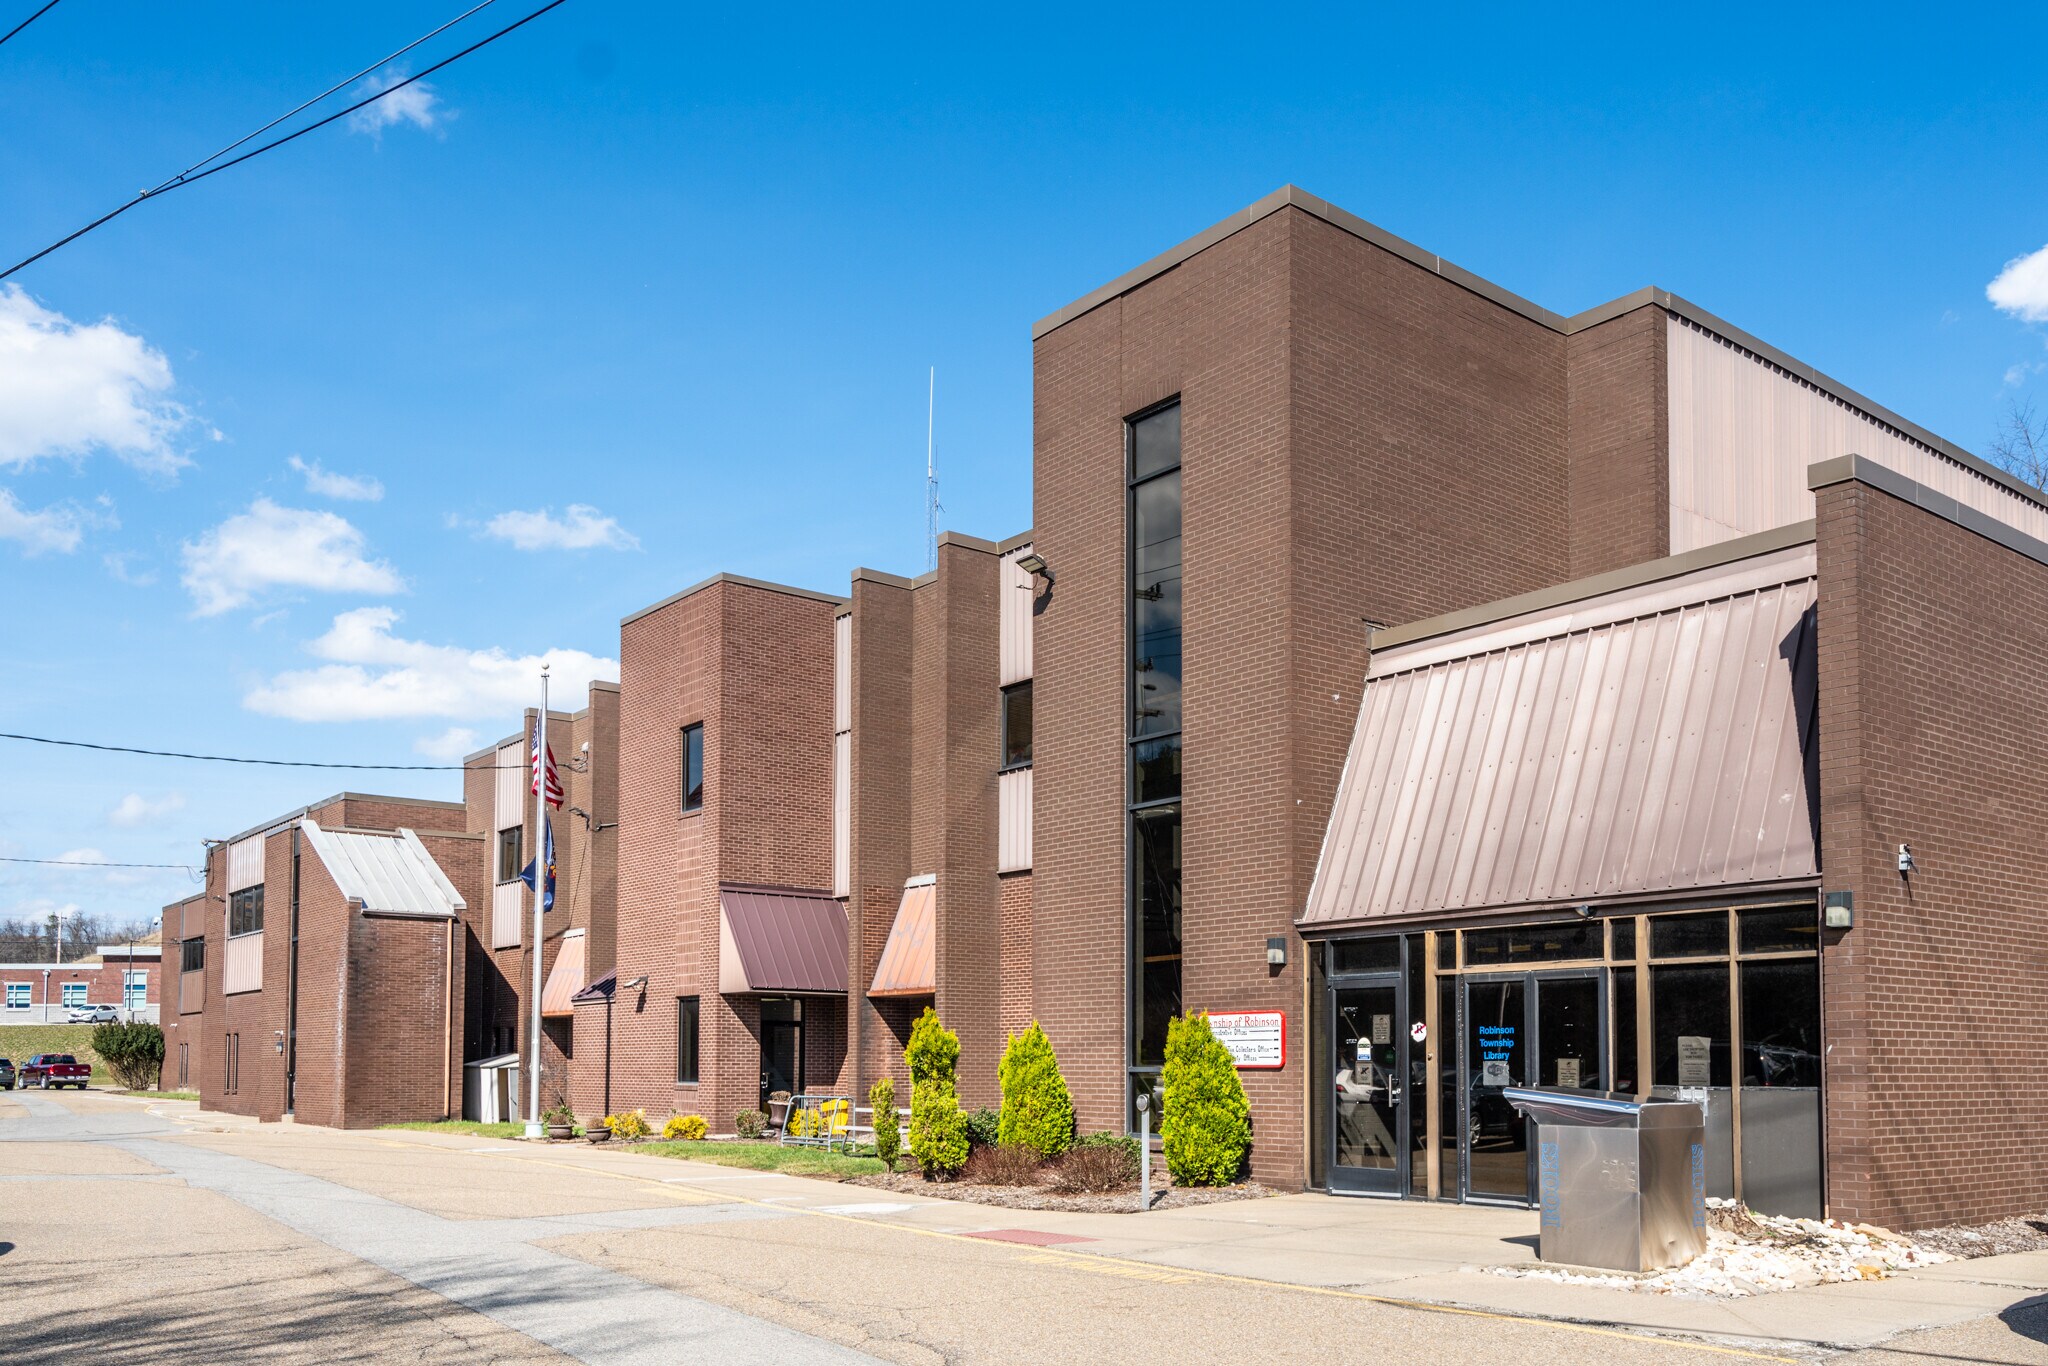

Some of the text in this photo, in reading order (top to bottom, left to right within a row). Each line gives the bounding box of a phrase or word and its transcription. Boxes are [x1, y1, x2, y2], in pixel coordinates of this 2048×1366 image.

[1209, 1015, 1279, 1029] nship of Robinson
[1479, 1026, 1515, 1035] Robinson
[1479, 1039, 1515, 1048] Township
[1484, 1052, 1509, 1061] Library
